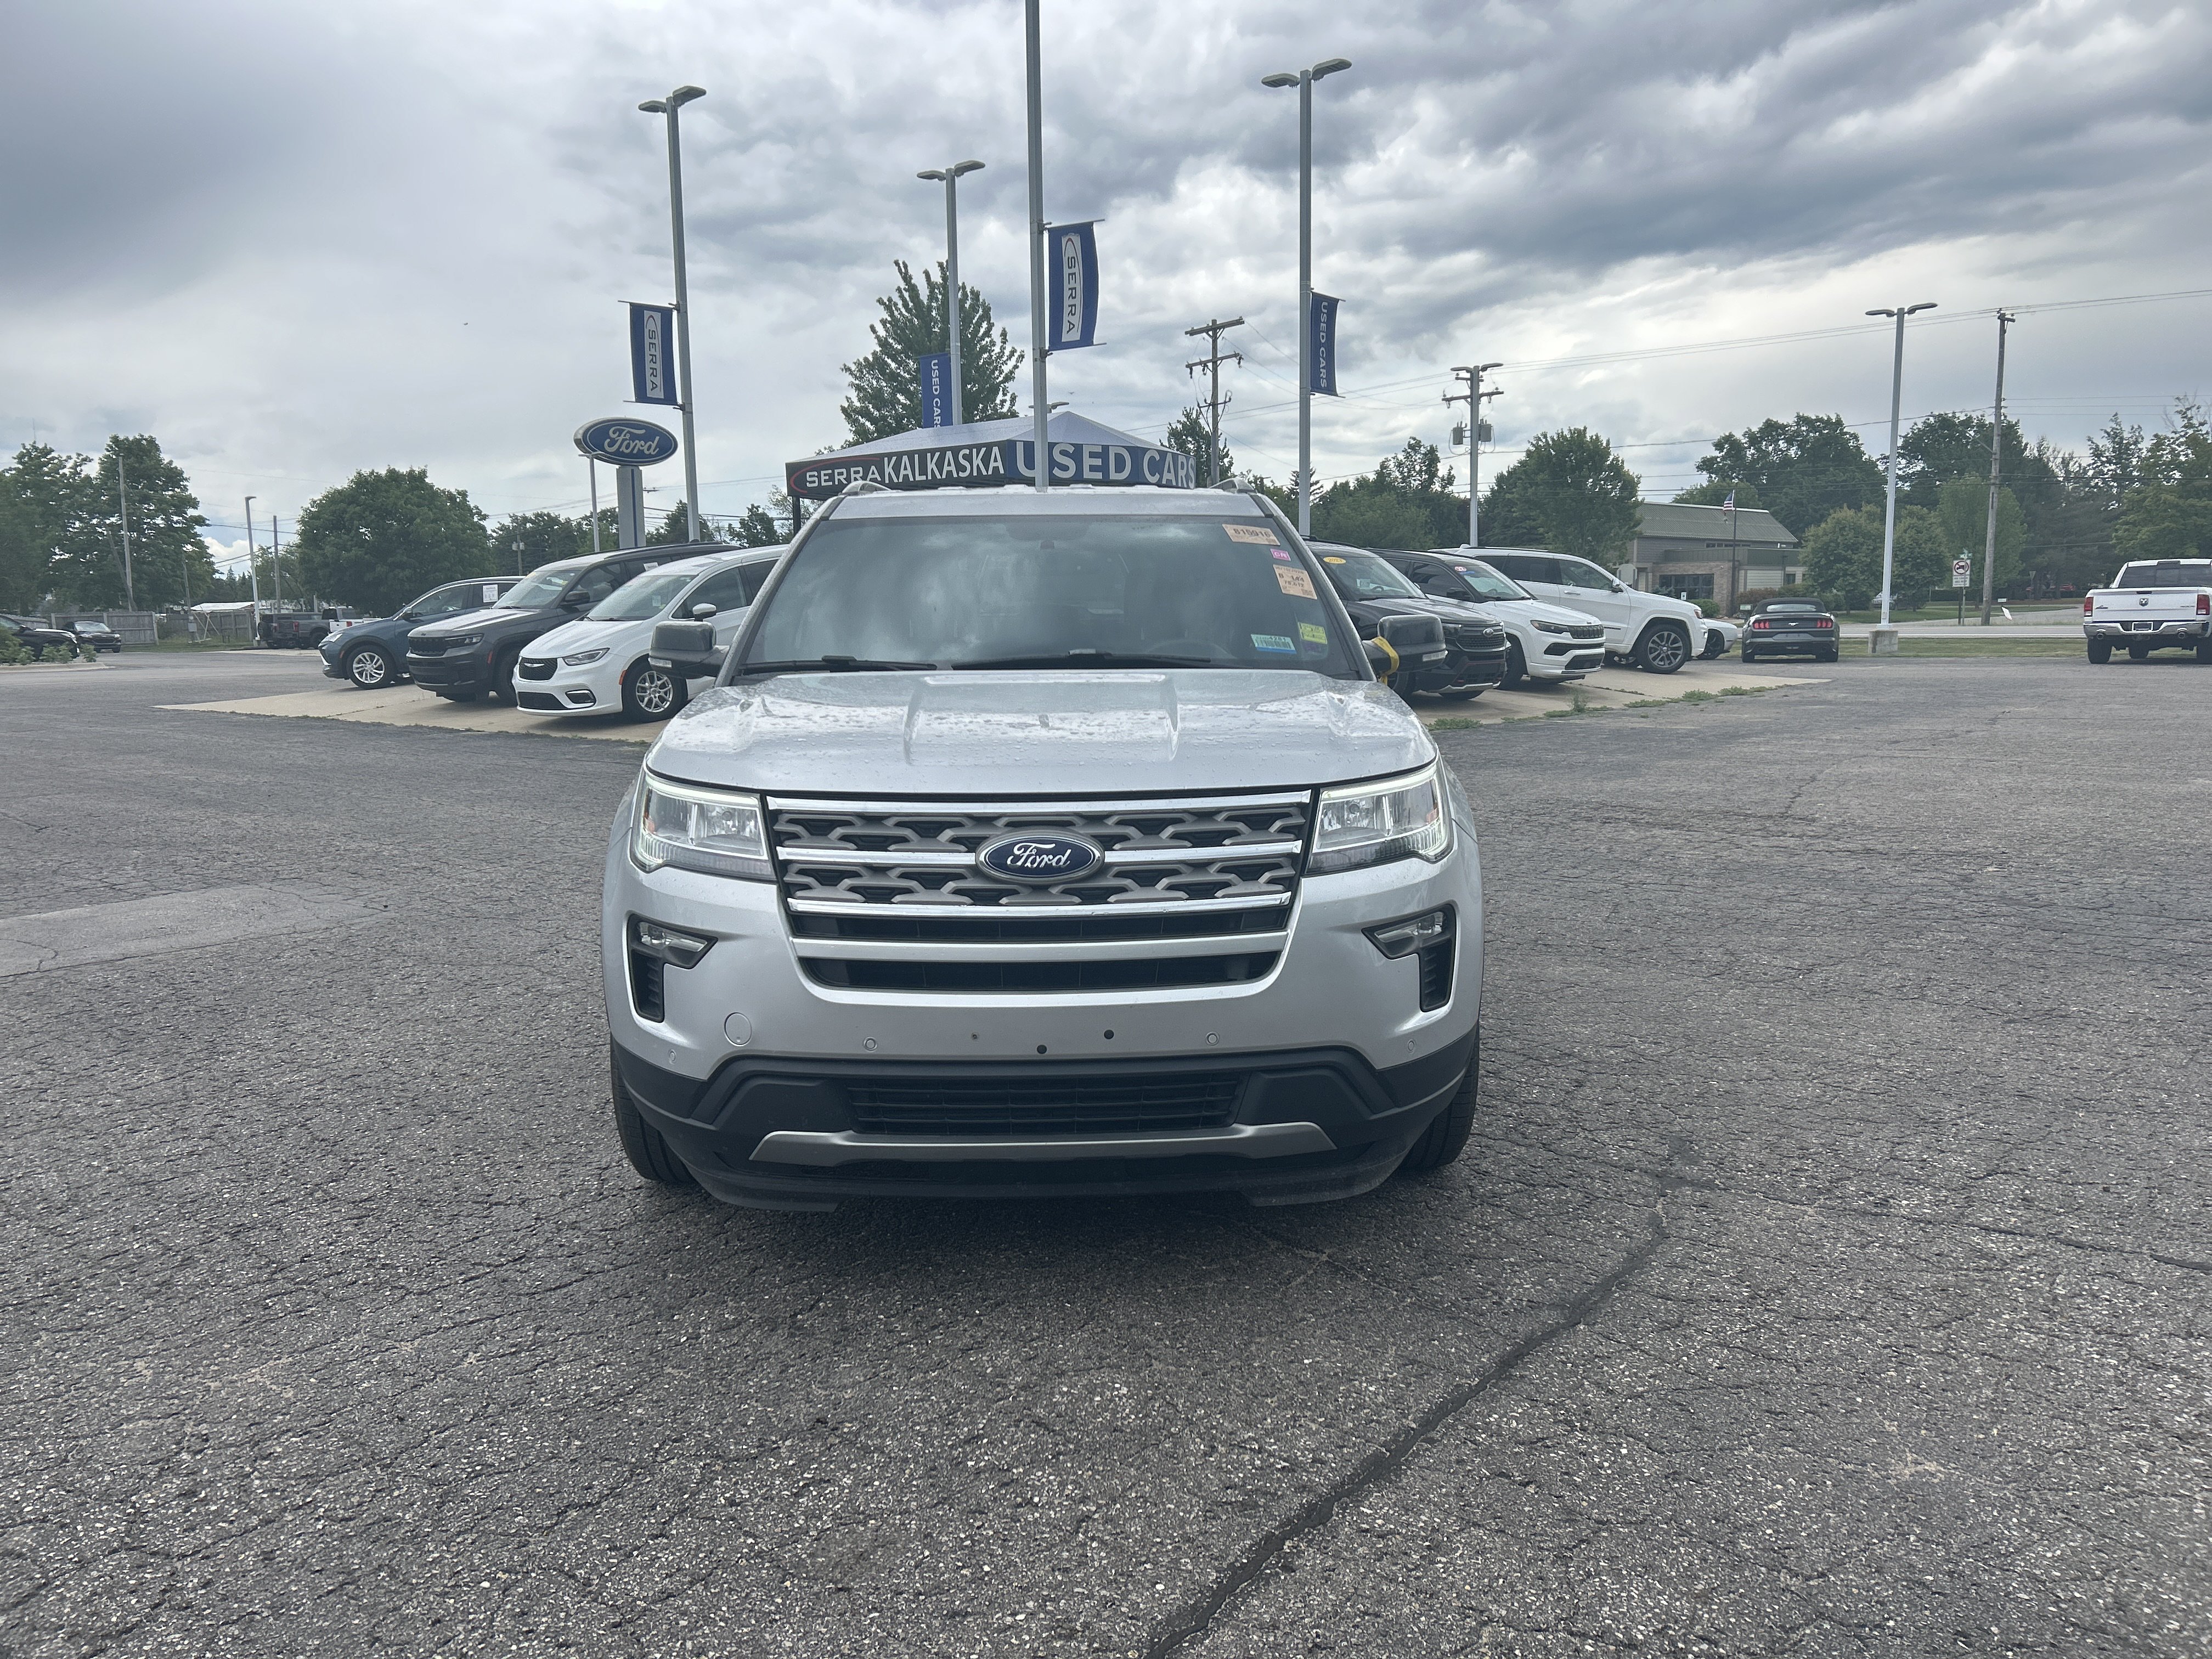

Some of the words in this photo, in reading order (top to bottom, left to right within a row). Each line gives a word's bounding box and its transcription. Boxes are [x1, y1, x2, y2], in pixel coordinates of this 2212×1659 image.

[1065, 256, 1076, 334] SERRA
[1319, 302, 1328, 343] USED
[648, 329, 658, 391] SERRA
[931, 360, 940, 395] USED
[604, 426, 659, 455] Ford
[806, 466, 882, 487] SERRA
[884, 446, 1005, 483] KALKASKA
[1016, 441, 1131, 480] USED
[1143, 449, 1195, 489] CARS
[1006, 842, 1072, 868] Ford
